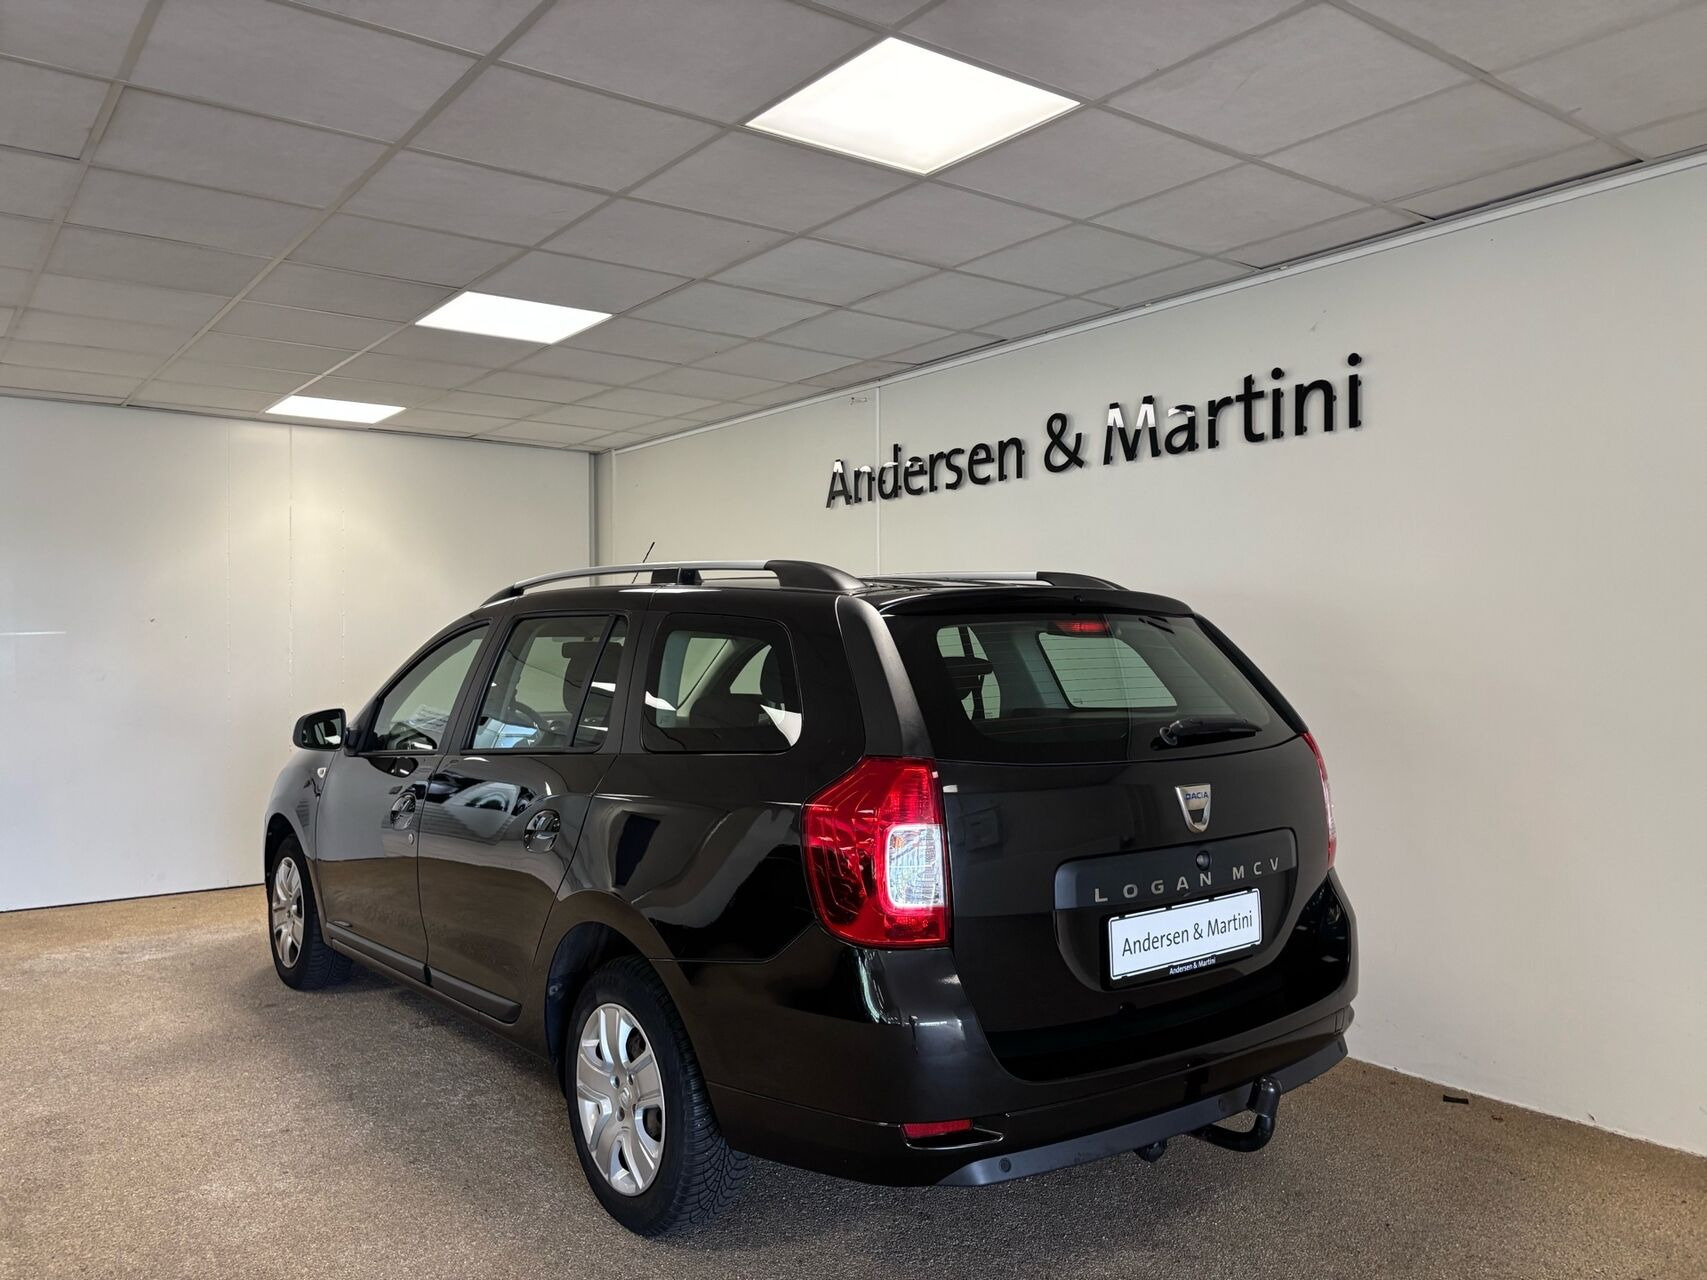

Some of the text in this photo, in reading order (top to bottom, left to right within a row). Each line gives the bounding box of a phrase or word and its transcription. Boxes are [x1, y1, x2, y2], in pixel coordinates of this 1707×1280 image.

[825, 353, 1361, 508] Andersen & Martini
[1185, 791, 1209, 800] DACIA
[1094, 857, 1279, 902] LOGAN MCV
[1121, 910, 1253, 957] Andersen & Martini
[1169, 957, 1216, 975] Andersen & Martini
